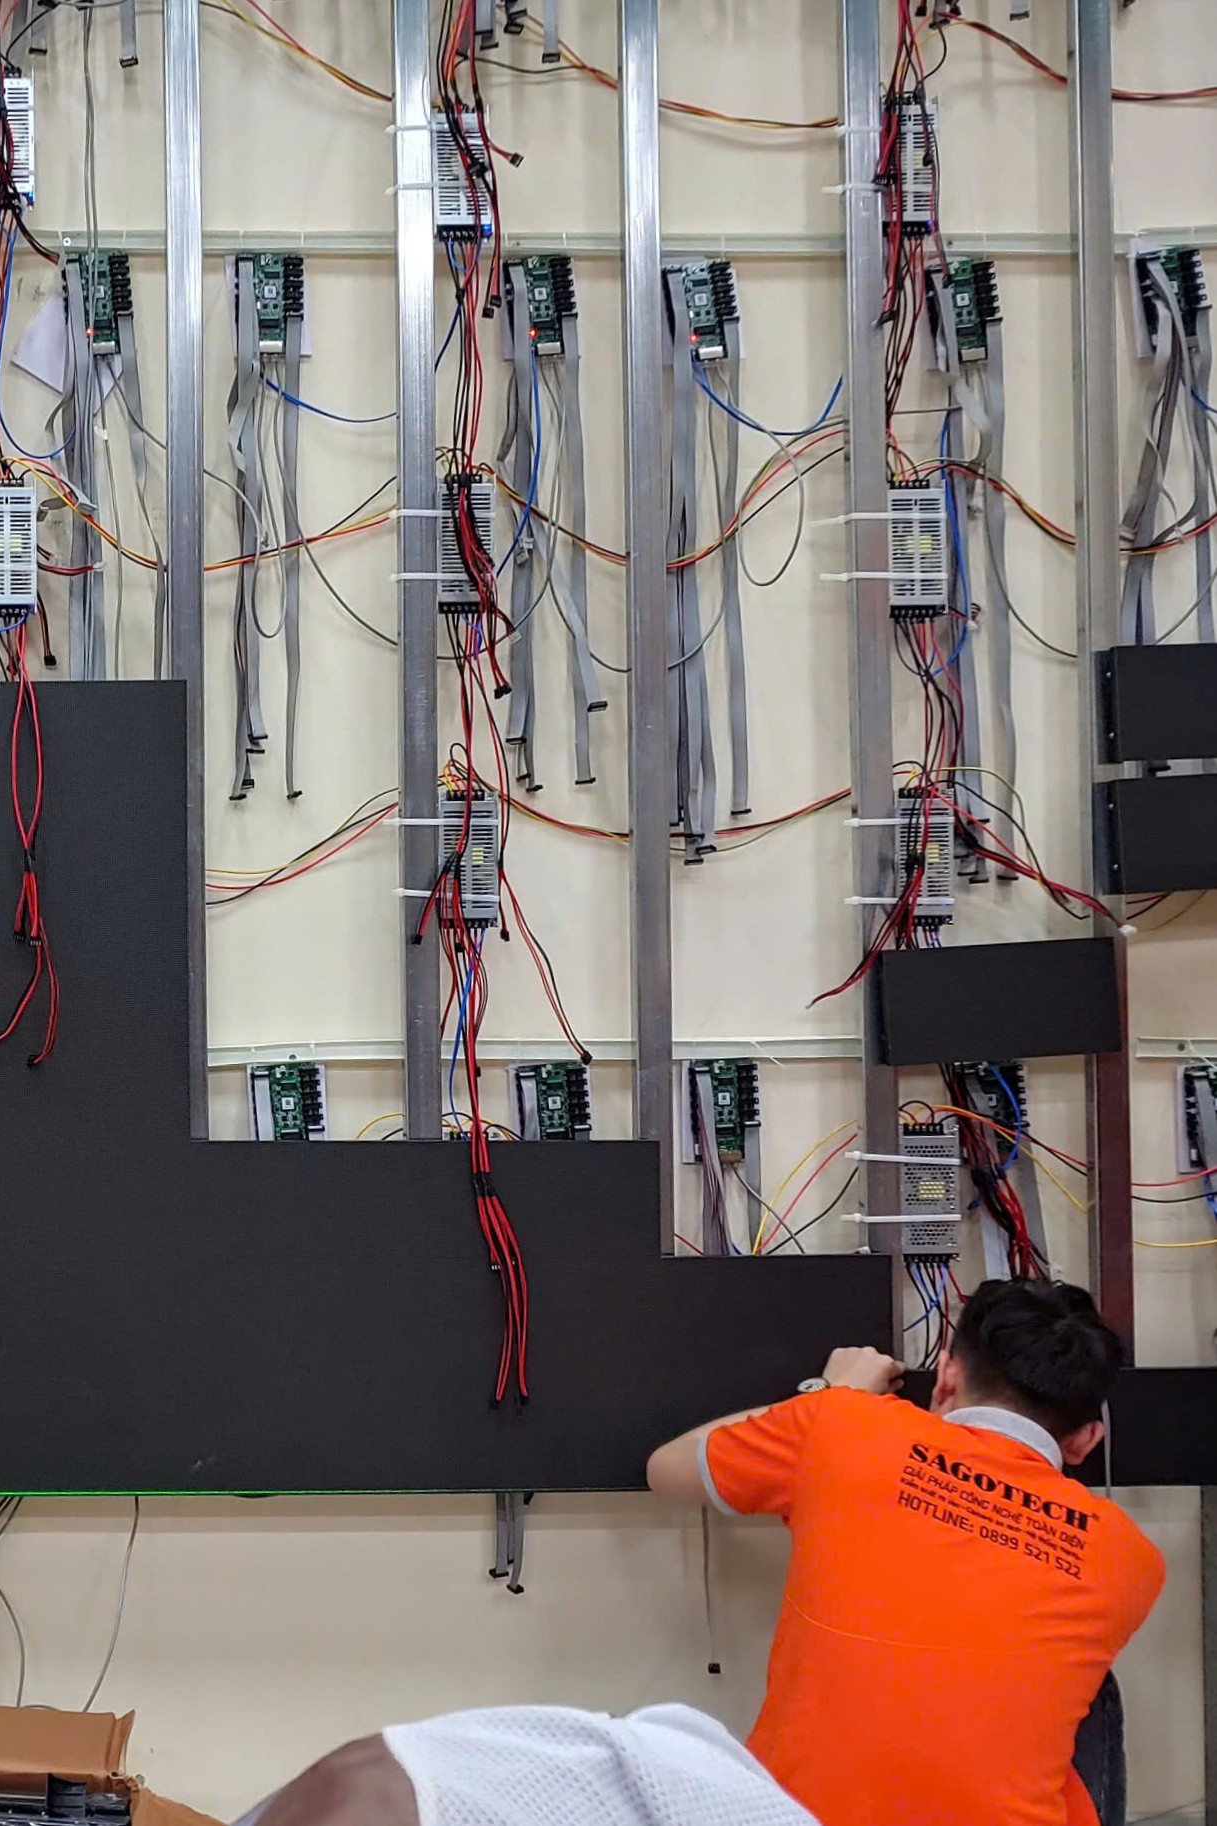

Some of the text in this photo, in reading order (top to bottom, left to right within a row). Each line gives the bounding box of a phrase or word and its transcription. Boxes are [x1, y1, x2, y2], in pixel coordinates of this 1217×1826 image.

[927, 1472, 959, 1494] PHÁP
[959, 1487, 990, 1510] CÔNG
[898, 1490, 1082, 1580] HOTLINE: 0899 521 522
